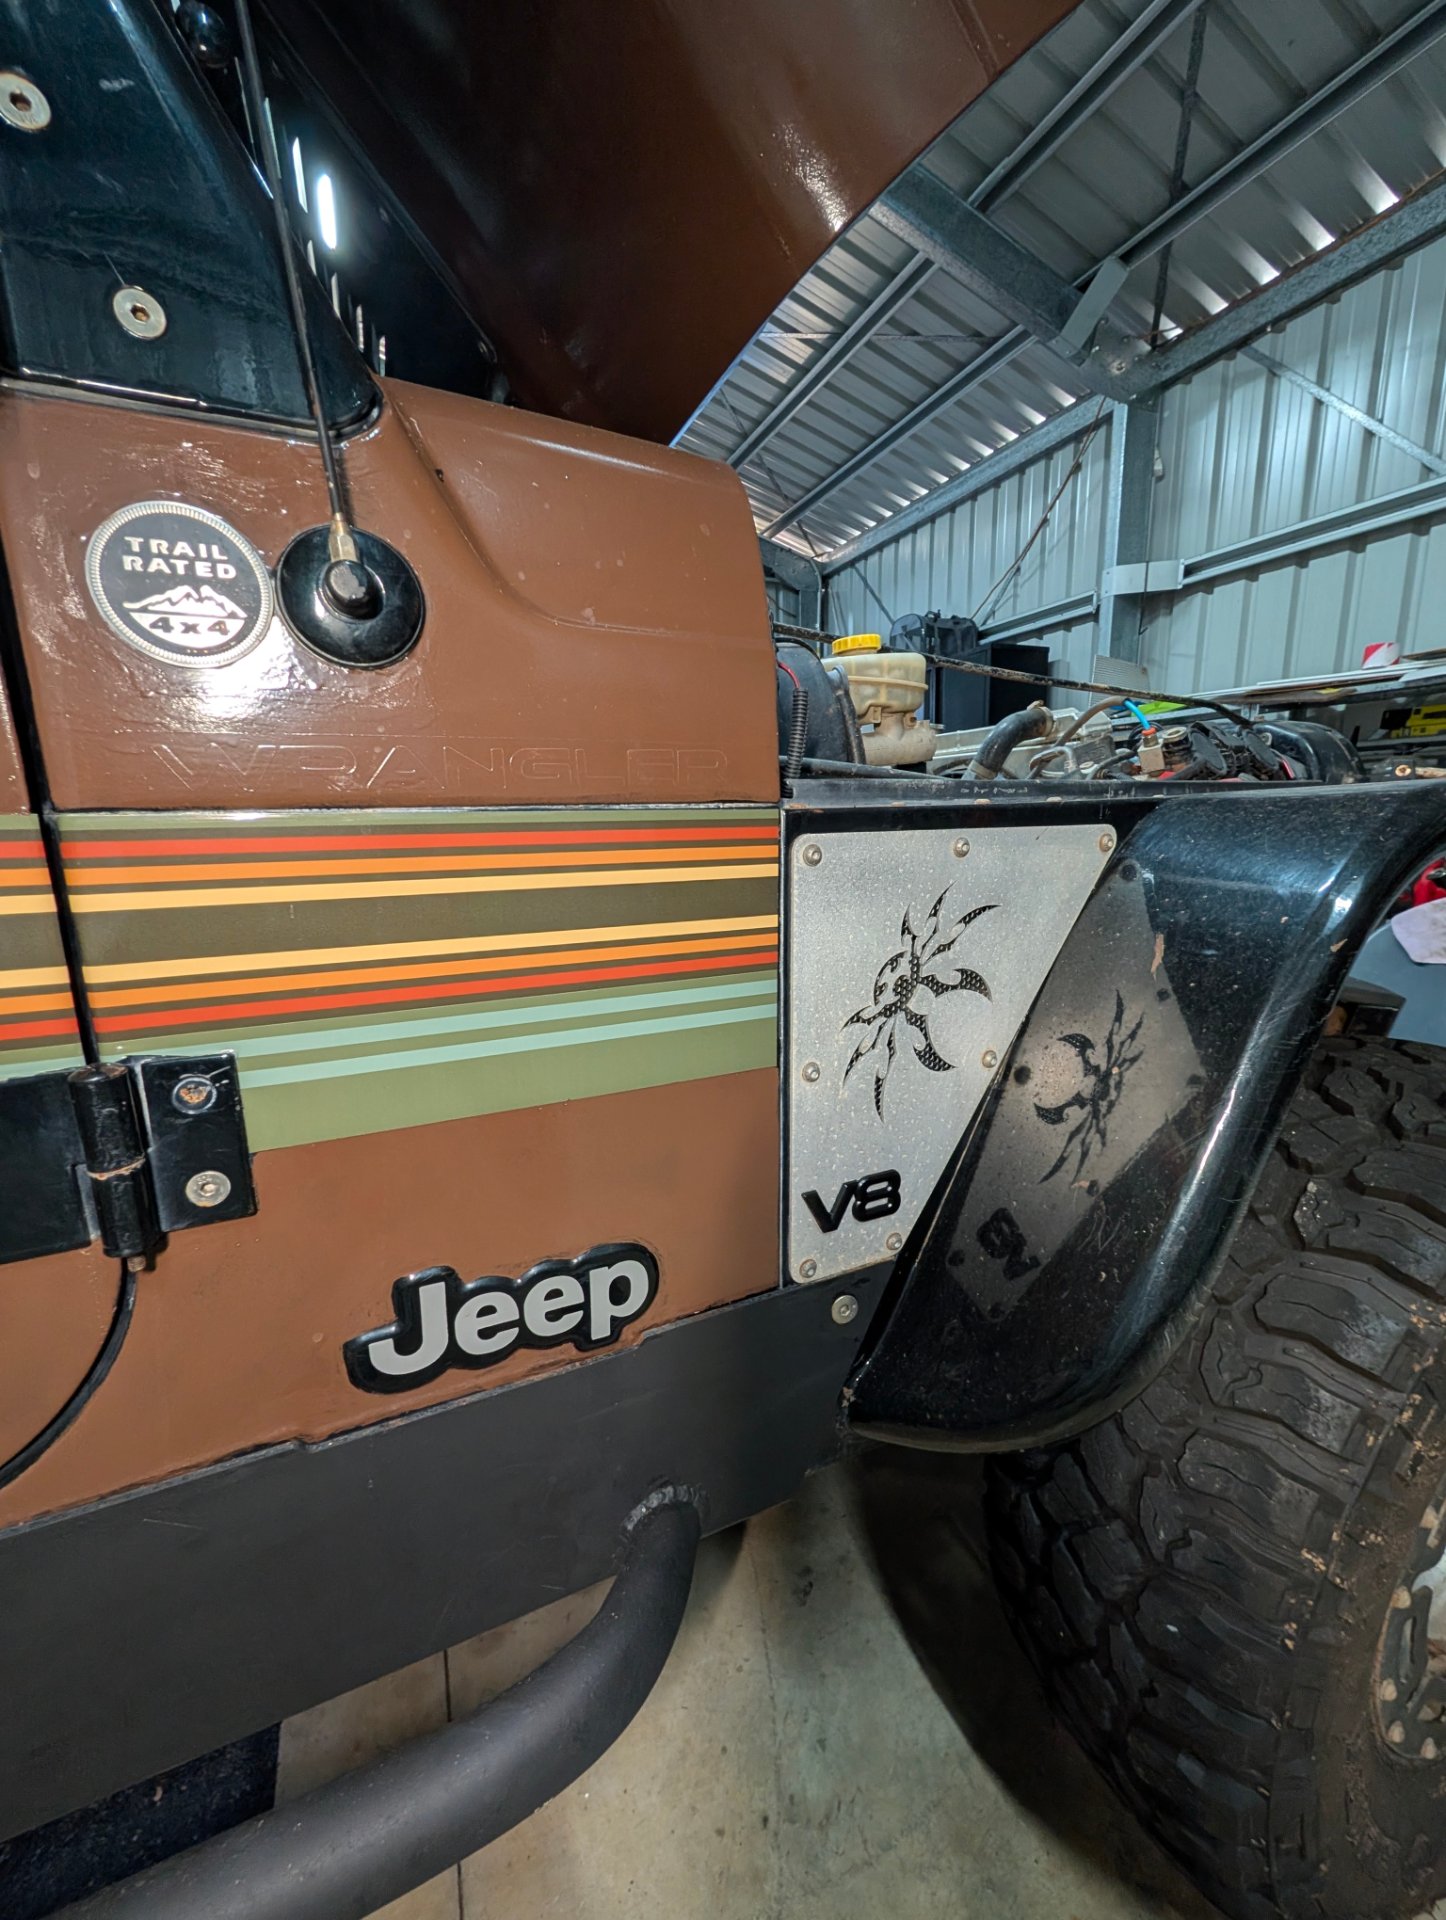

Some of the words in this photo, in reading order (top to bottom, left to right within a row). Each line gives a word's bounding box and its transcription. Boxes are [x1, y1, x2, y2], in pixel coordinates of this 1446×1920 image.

[124, 536, 228, 560] TRAIL
[122, 555, 237, 579] RATED
[149, 616, 230, 636] 4x4
[801, 1168, 901, 1234] V8
[368, 1259, 649, 1376] Jeep
